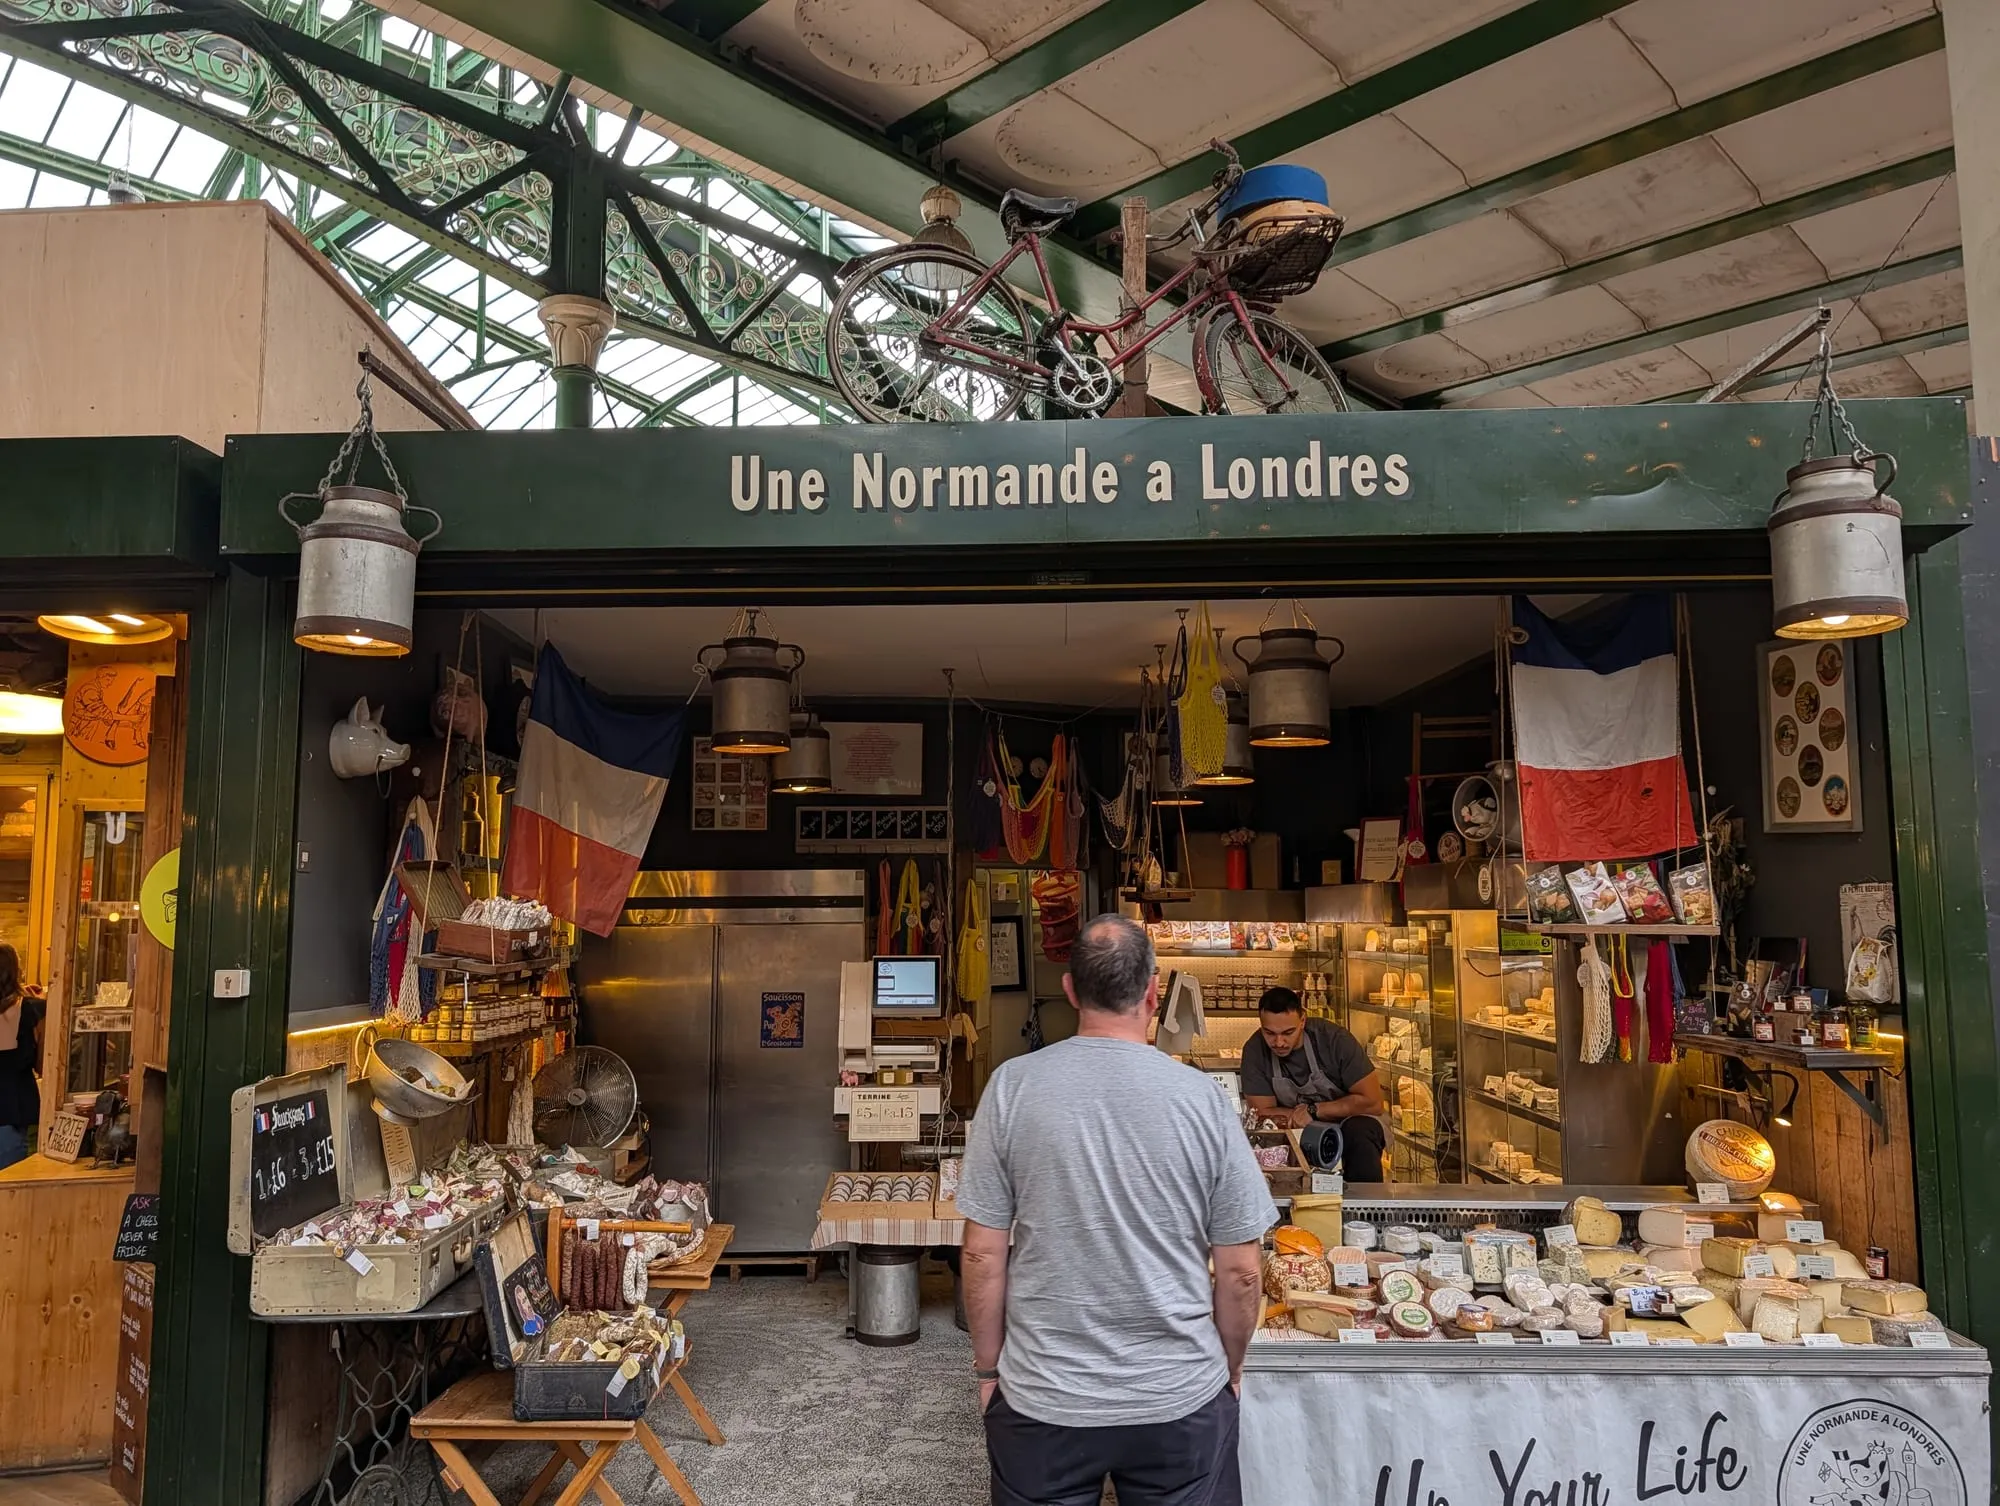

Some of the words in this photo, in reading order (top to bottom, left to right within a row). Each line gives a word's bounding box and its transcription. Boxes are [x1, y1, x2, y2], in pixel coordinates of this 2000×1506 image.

[731, 455, 826, 512] Une
[852, 447, 1120, 509] Normande
[1146, 460, 1173, 501] a
[1201, 440, 1410, 500] Londres
[763, 993, 803, 1002] Saucisson
[857, 1093, 892, 1101] TERRINE
[316, 1136, 335, 1175] £15
[129, 1197, 149, 1211] ASK
[123, 1214, 131, 1228] A
[118, 1231, 144, 1243] NEVER
[116, 1245, 147, 1258] FRIDGE
[1795, 1440, 1813, 1466] UNE
[1809, 1410, 1879, 1442] NORMANDE
[1880, 1414, 1890, 1424] A
[1892, 1417, 1946, 1467] LONDRES
[1636, 1410, 1748, 1501] Life
